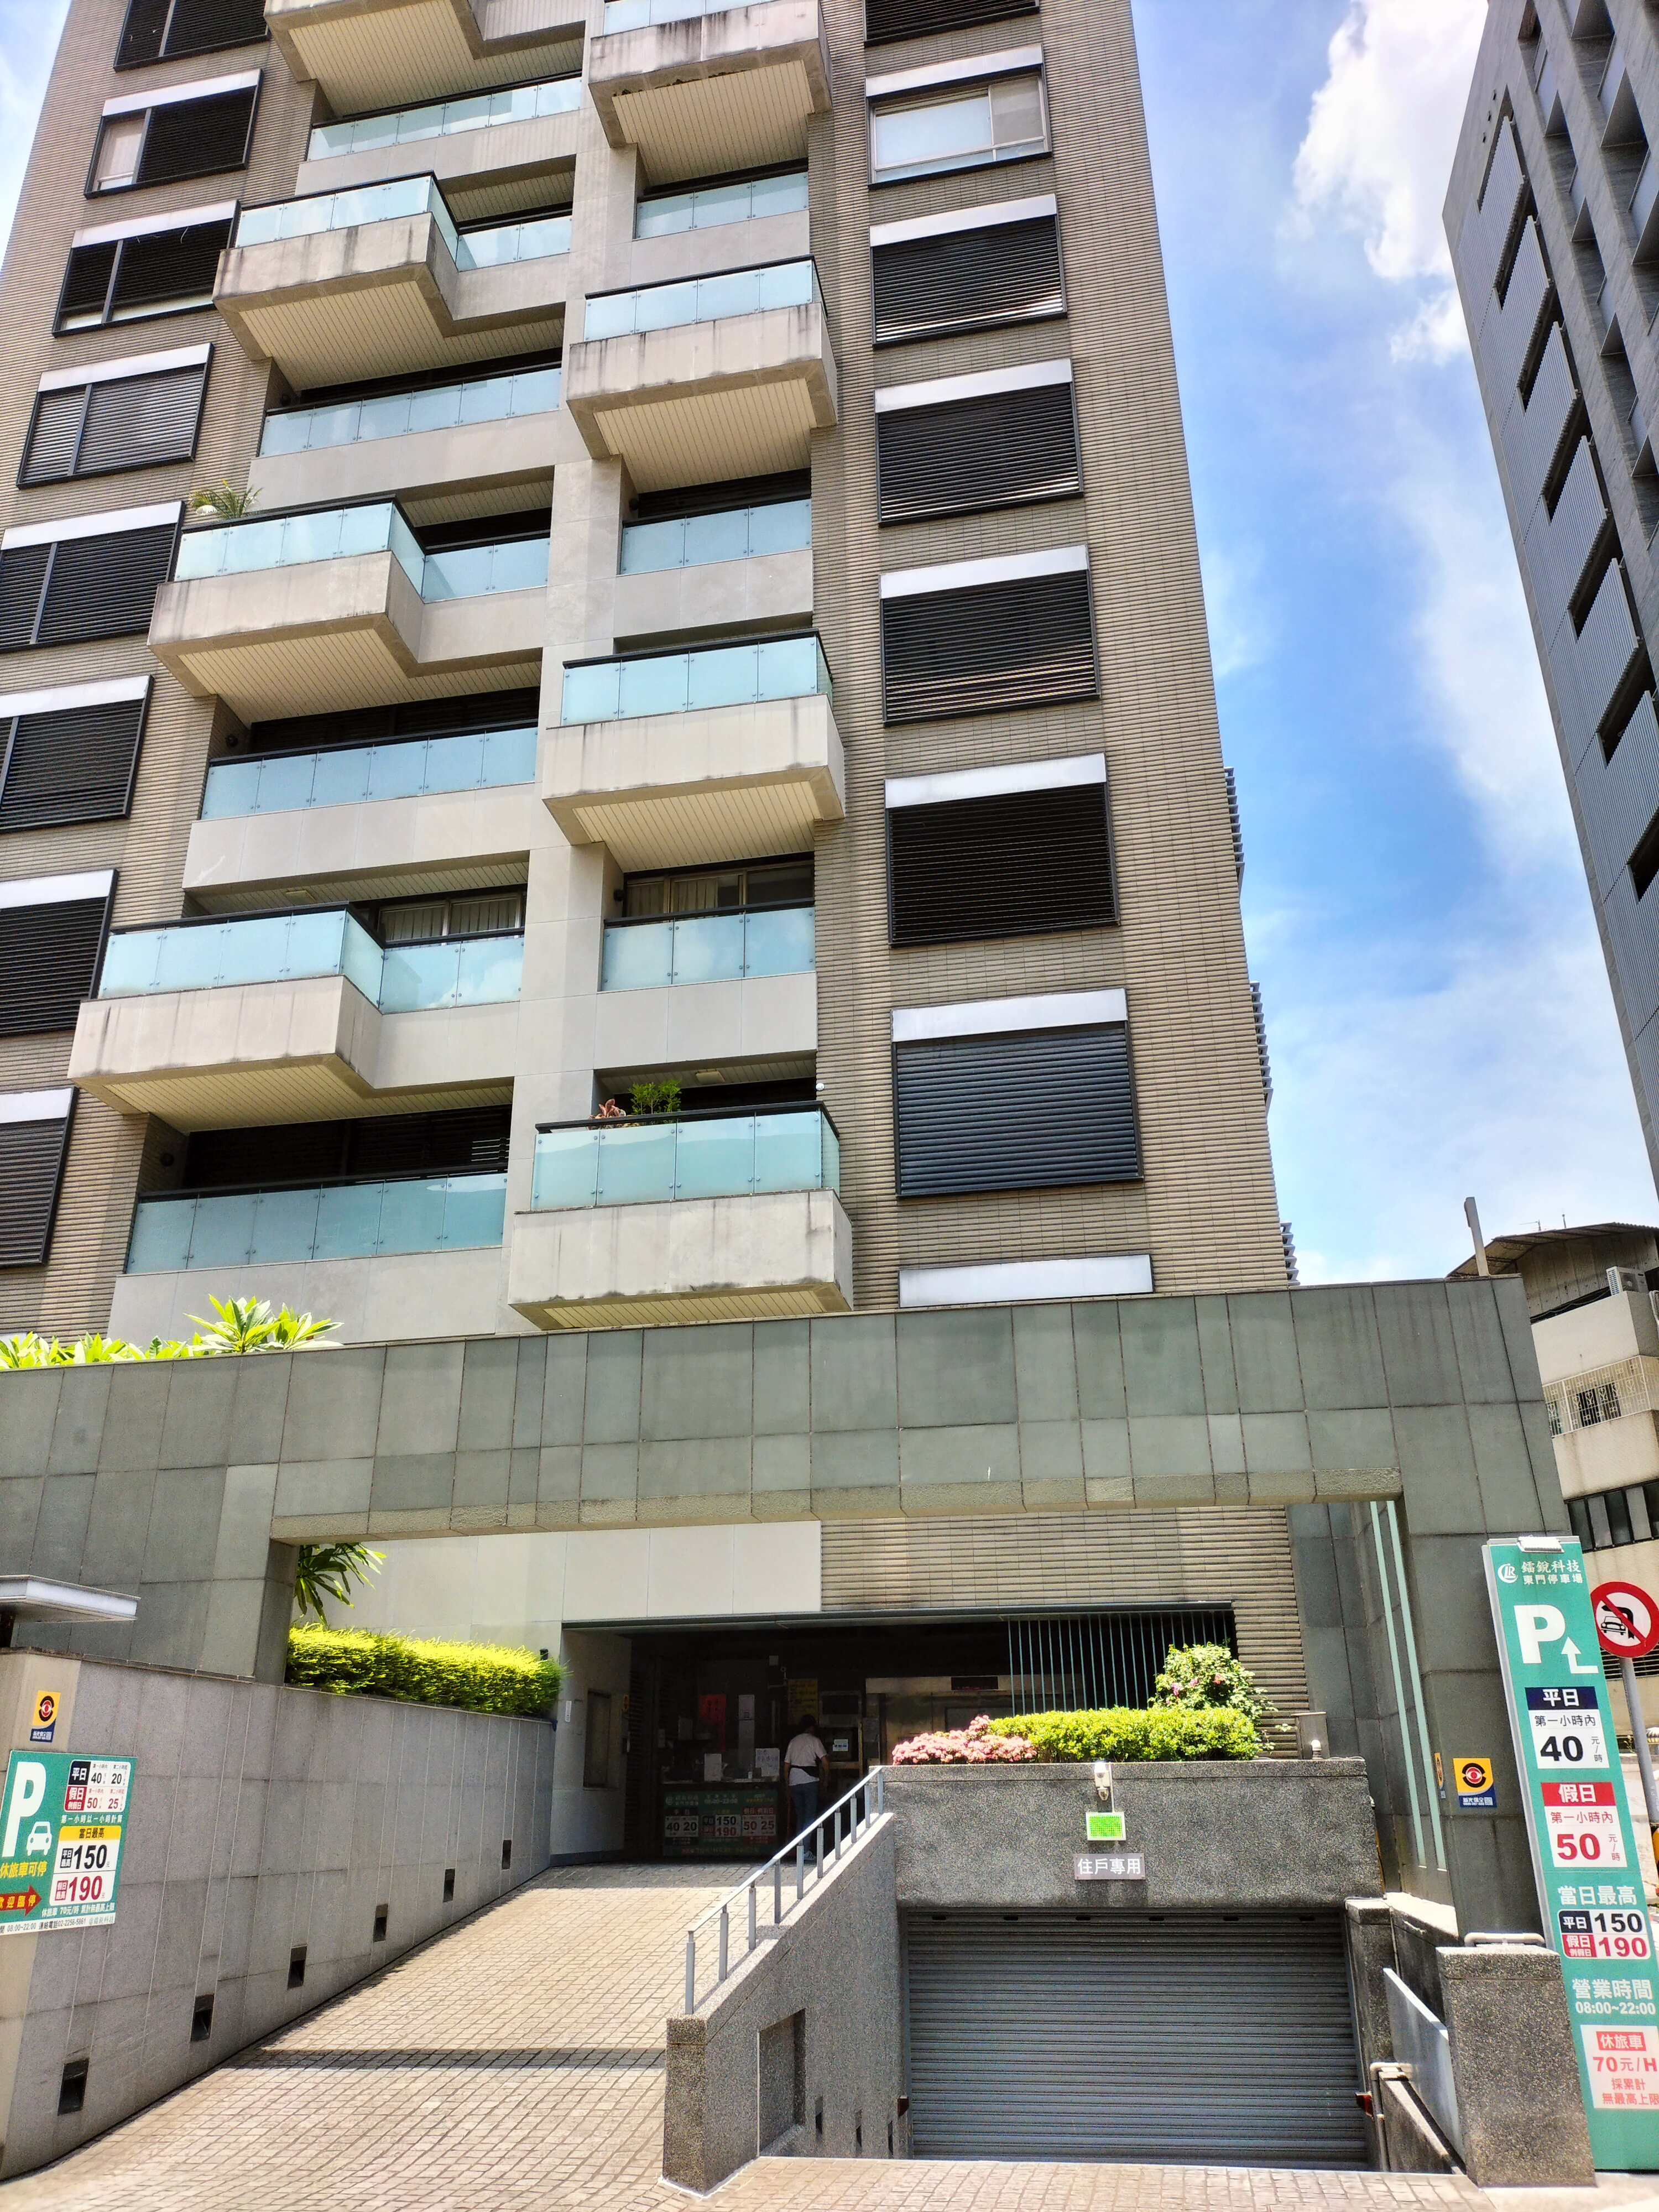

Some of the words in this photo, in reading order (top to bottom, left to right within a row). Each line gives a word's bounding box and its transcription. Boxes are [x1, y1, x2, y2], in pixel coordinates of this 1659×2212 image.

[1521, 1559, 1582, 1573] 鐳銳科技
[1523, 1573, 1583, 1585] 東門停車場
[1514, 1605, 1566, 1664] P
[1542, 1689, 1579, 1707] 平日
[1534, 1715, 1596, 1727] 第一小時內
[1540, 1736, 1584, 1762] 40
[71, 1767, 87, 1781] 平日
[91, 1772, 102, 1784] 40
[111, 1773, 122, 1785] 20
[69, 1787, 85, 1801] 假日
[1558, 1783, 1597, 1803] 假日
[2, 1761, 46, 1857] P
[86, 1797, 98, 1809] 50
[107, 1798, 119, 1809] 25
[717, 1816, 737, 1825] 150
[744, 1821, 758, 1830] 50
[761, 1820, 774, 1830] 25
[1551, 1812, 1614, 1824] 第一小時內
[79, 1827, 105, 1839] 當日最高
[666, 1822, 680, 1832] 40
[684, 1822, 697, 1831] 20
[717, 1827, 737, 1837] 190
[1557, 1833, 1601, 1860] 50
[73, 1844, 108, 1870] 150
[0, 1861, 48, 1879] 休旅車可停
[1077, 1858, 1141, 1875] 住戶專用
[69, 1875, 103, 1902] 190
[1557, 1885, 1637, 1906] 當日最高
[1563, 1916, 1588, 1929] 平日
[1594, 1913, 1642, 1933] 150
[1566, 1936, 1590, 1948] 假日
[1598, 1937, 1647, 1958] 190
[1572, 1979, 1653, 2000] 營業時間
[1576, 2002, 1656, 2015] 08:00~22:00
[1600, 2033, 1644, 2049] 休旅車
[1611, 2078, 1646, 2091] 採累計
[1602, 2092, 1659, 2106] 無最高上限
